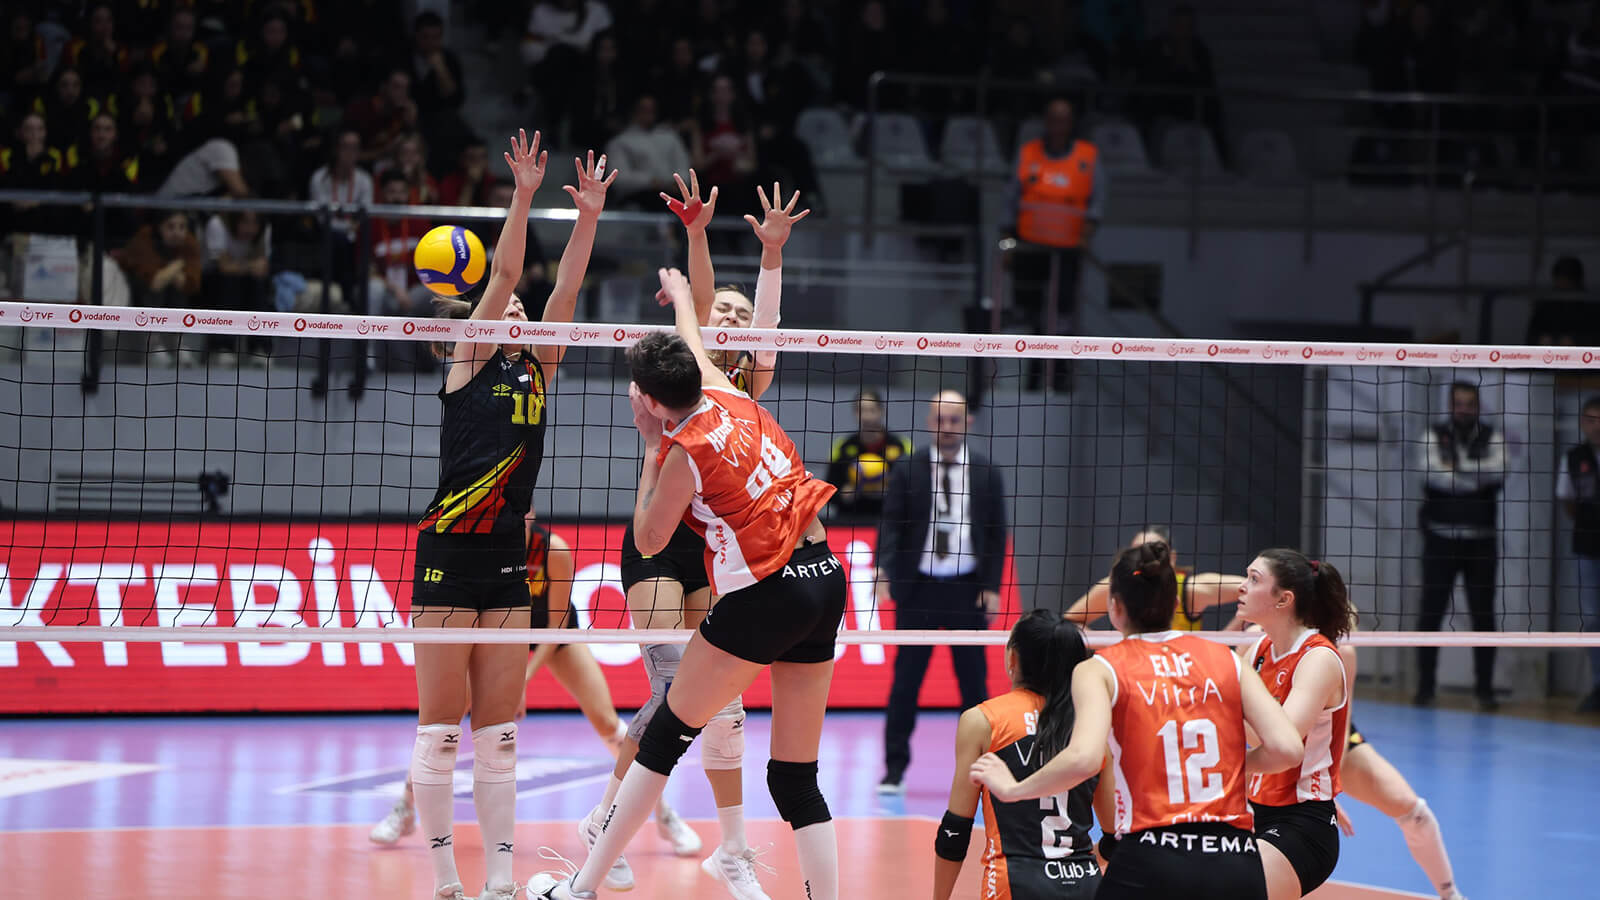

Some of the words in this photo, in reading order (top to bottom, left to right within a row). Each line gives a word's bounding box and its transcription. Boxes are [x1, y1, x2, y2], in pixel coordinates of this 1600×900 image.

[35, 312, 54, 320] TVF
[84, 313, 121, 322] vodafone
[150, 316, 169, 325] TVF
[197, 317, 233, 326] vodafone
[262, 321, 280, 329] TVF
[308, 321, 343, 330] vodafone
[371, 325, 389, 333] TVF
[416, 325, 451, 334] vodafone
[479, 328, 496, 337] TVF
[522, 328, 557, 337] vodafone
[729, 334, 762, 342] vodafone
[788, 337, 805, 345] TVF
[830, 337, 862, 346] vodafone
[888, 340, 905, 348] TVF
[512, 393, 541, 425] 10
[424, 567, 445, 583] 10
[782, 554, 841, 578] ARTEM
[1156, 718, 1225, 805] 12
[1039, 790, 1074, 859] 2
[1140, 831, 1257, 853] ARTEMA
[1044, 861, 1085, 879] Club
